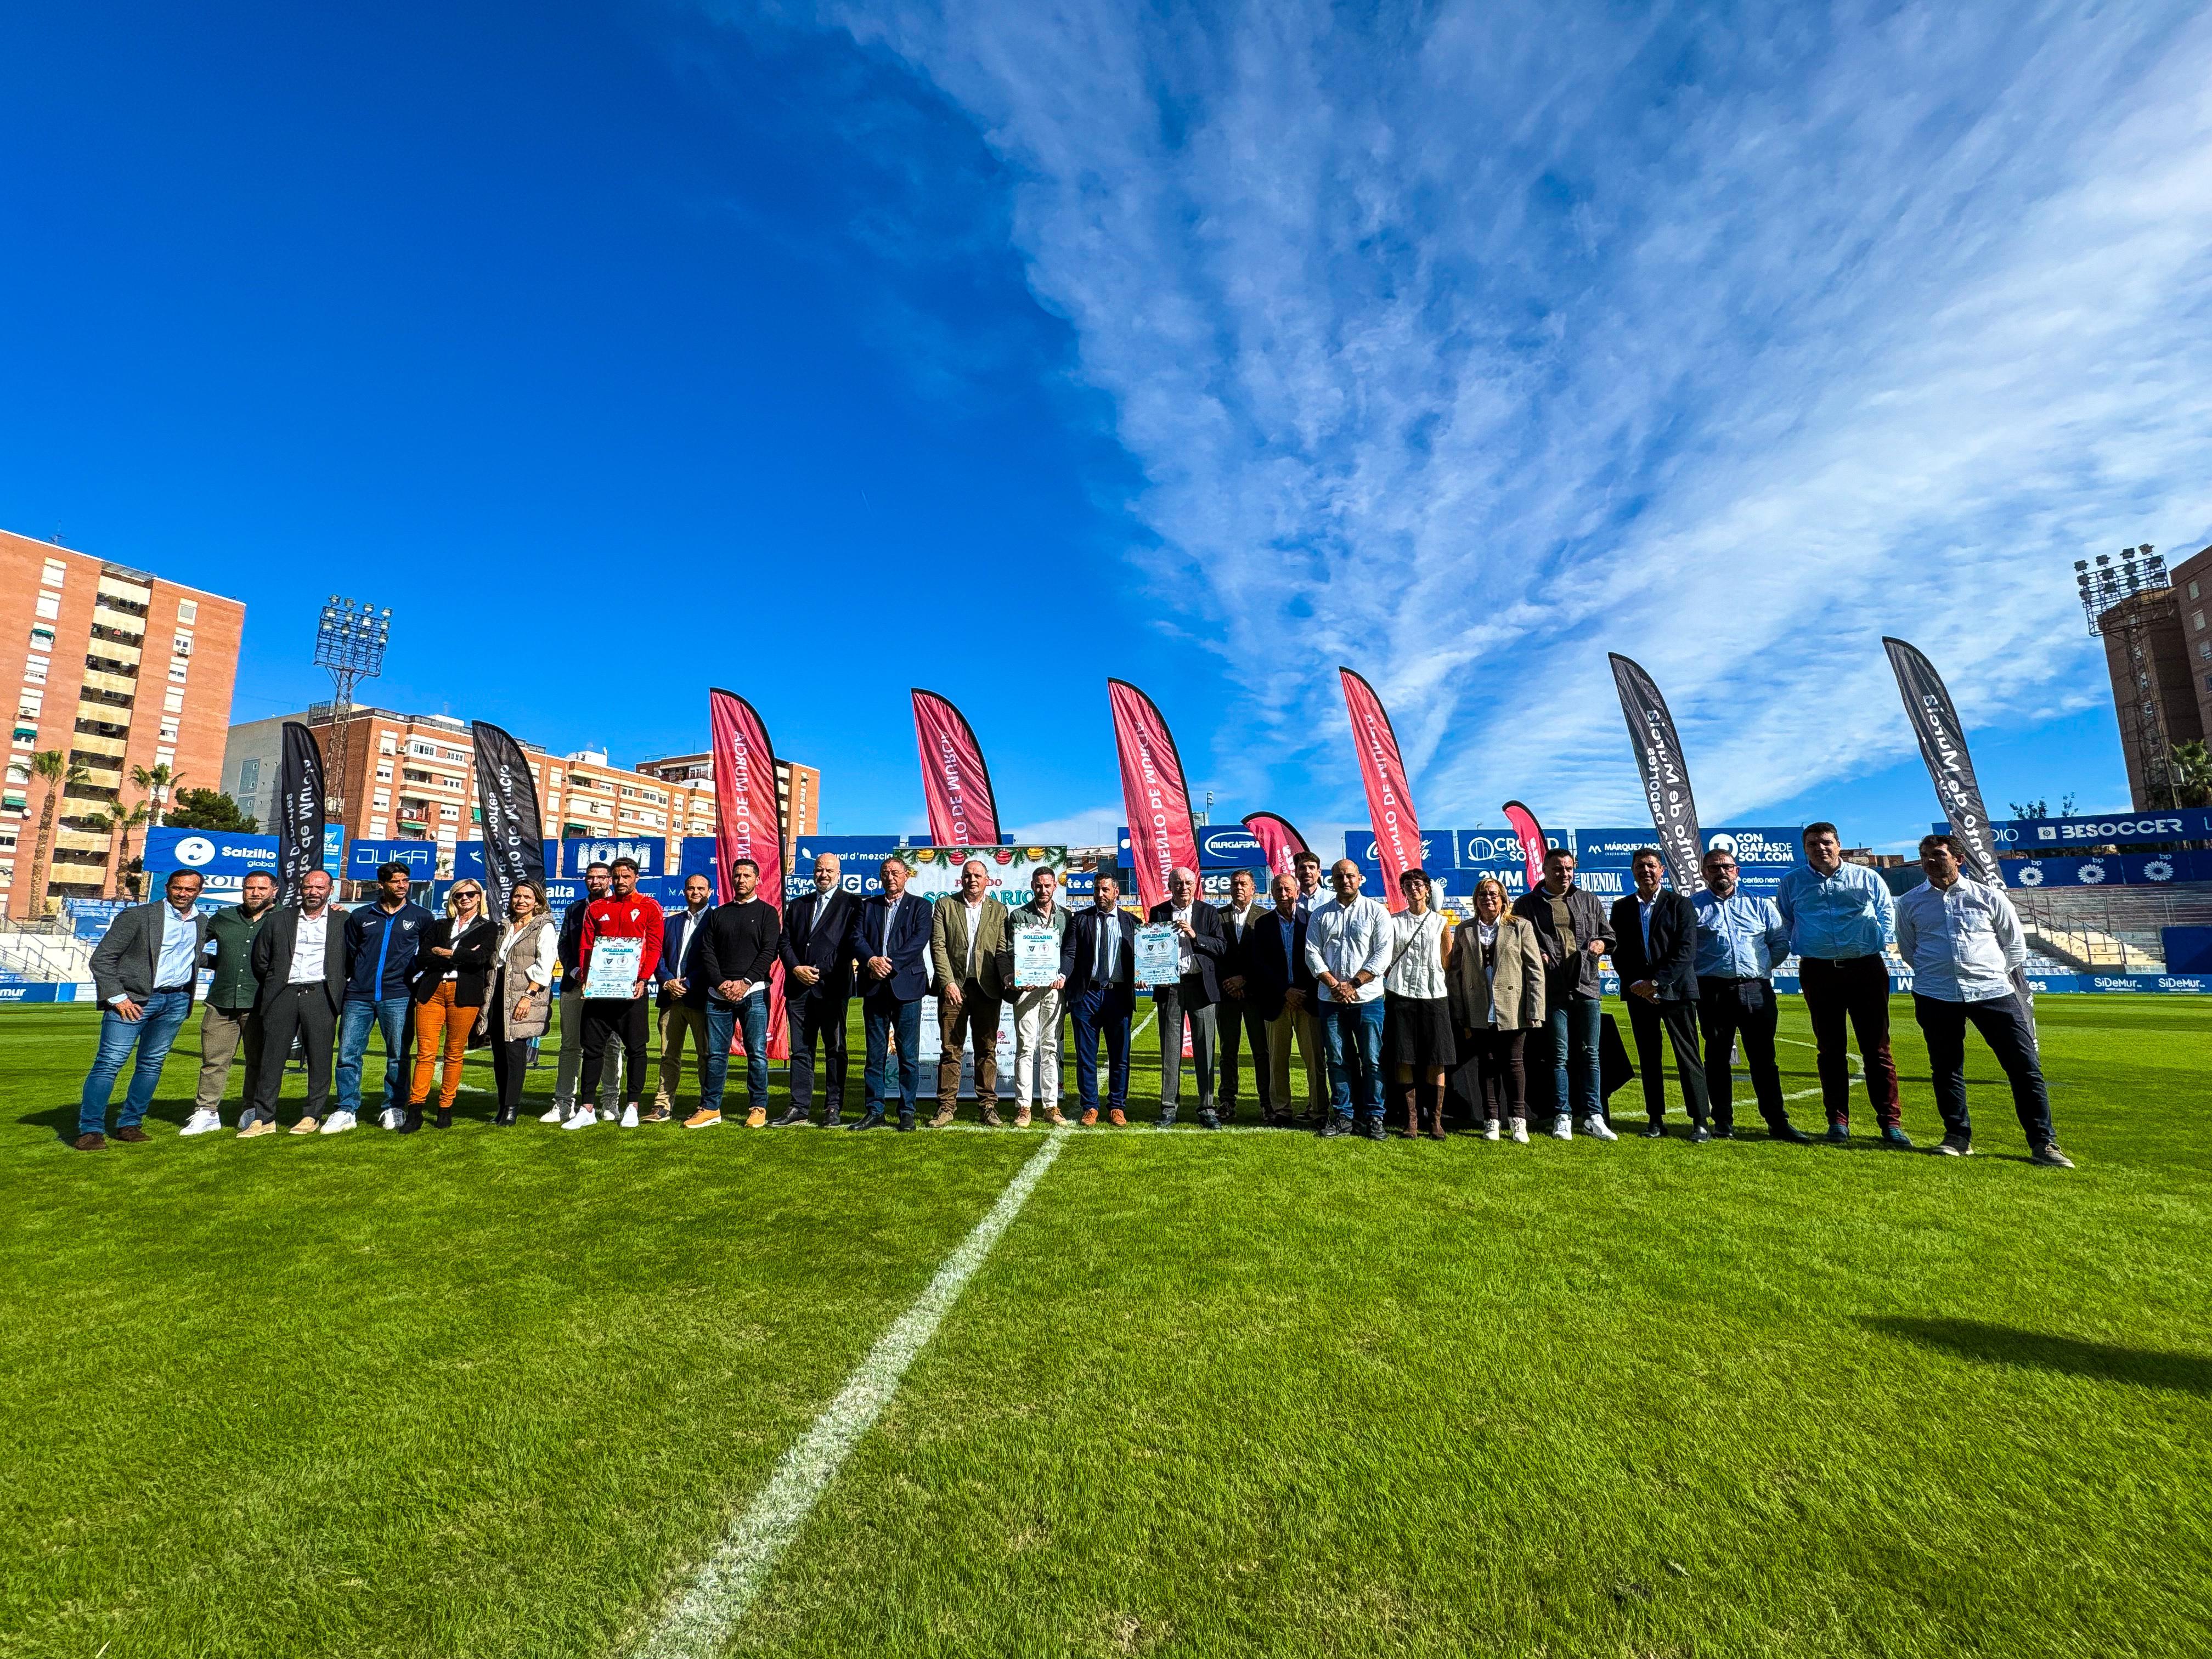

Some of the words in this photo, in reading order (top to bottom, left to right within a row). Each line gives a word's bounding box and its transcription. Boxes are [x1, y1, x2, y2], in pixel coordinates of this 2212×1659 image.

[2061, 819, 2183, 838] BESOCCER
[1736, 833, 1763, 843] CON
[222, 846, 276, 860] Salzillo
[1739, 851, 1795, 861] SOL.COM
[923, 890, 1034, 905] SOARIO
[2094, 978, 2136, 988] SiDeMur
[2158, 978, 2200, 988] SiDeMur
